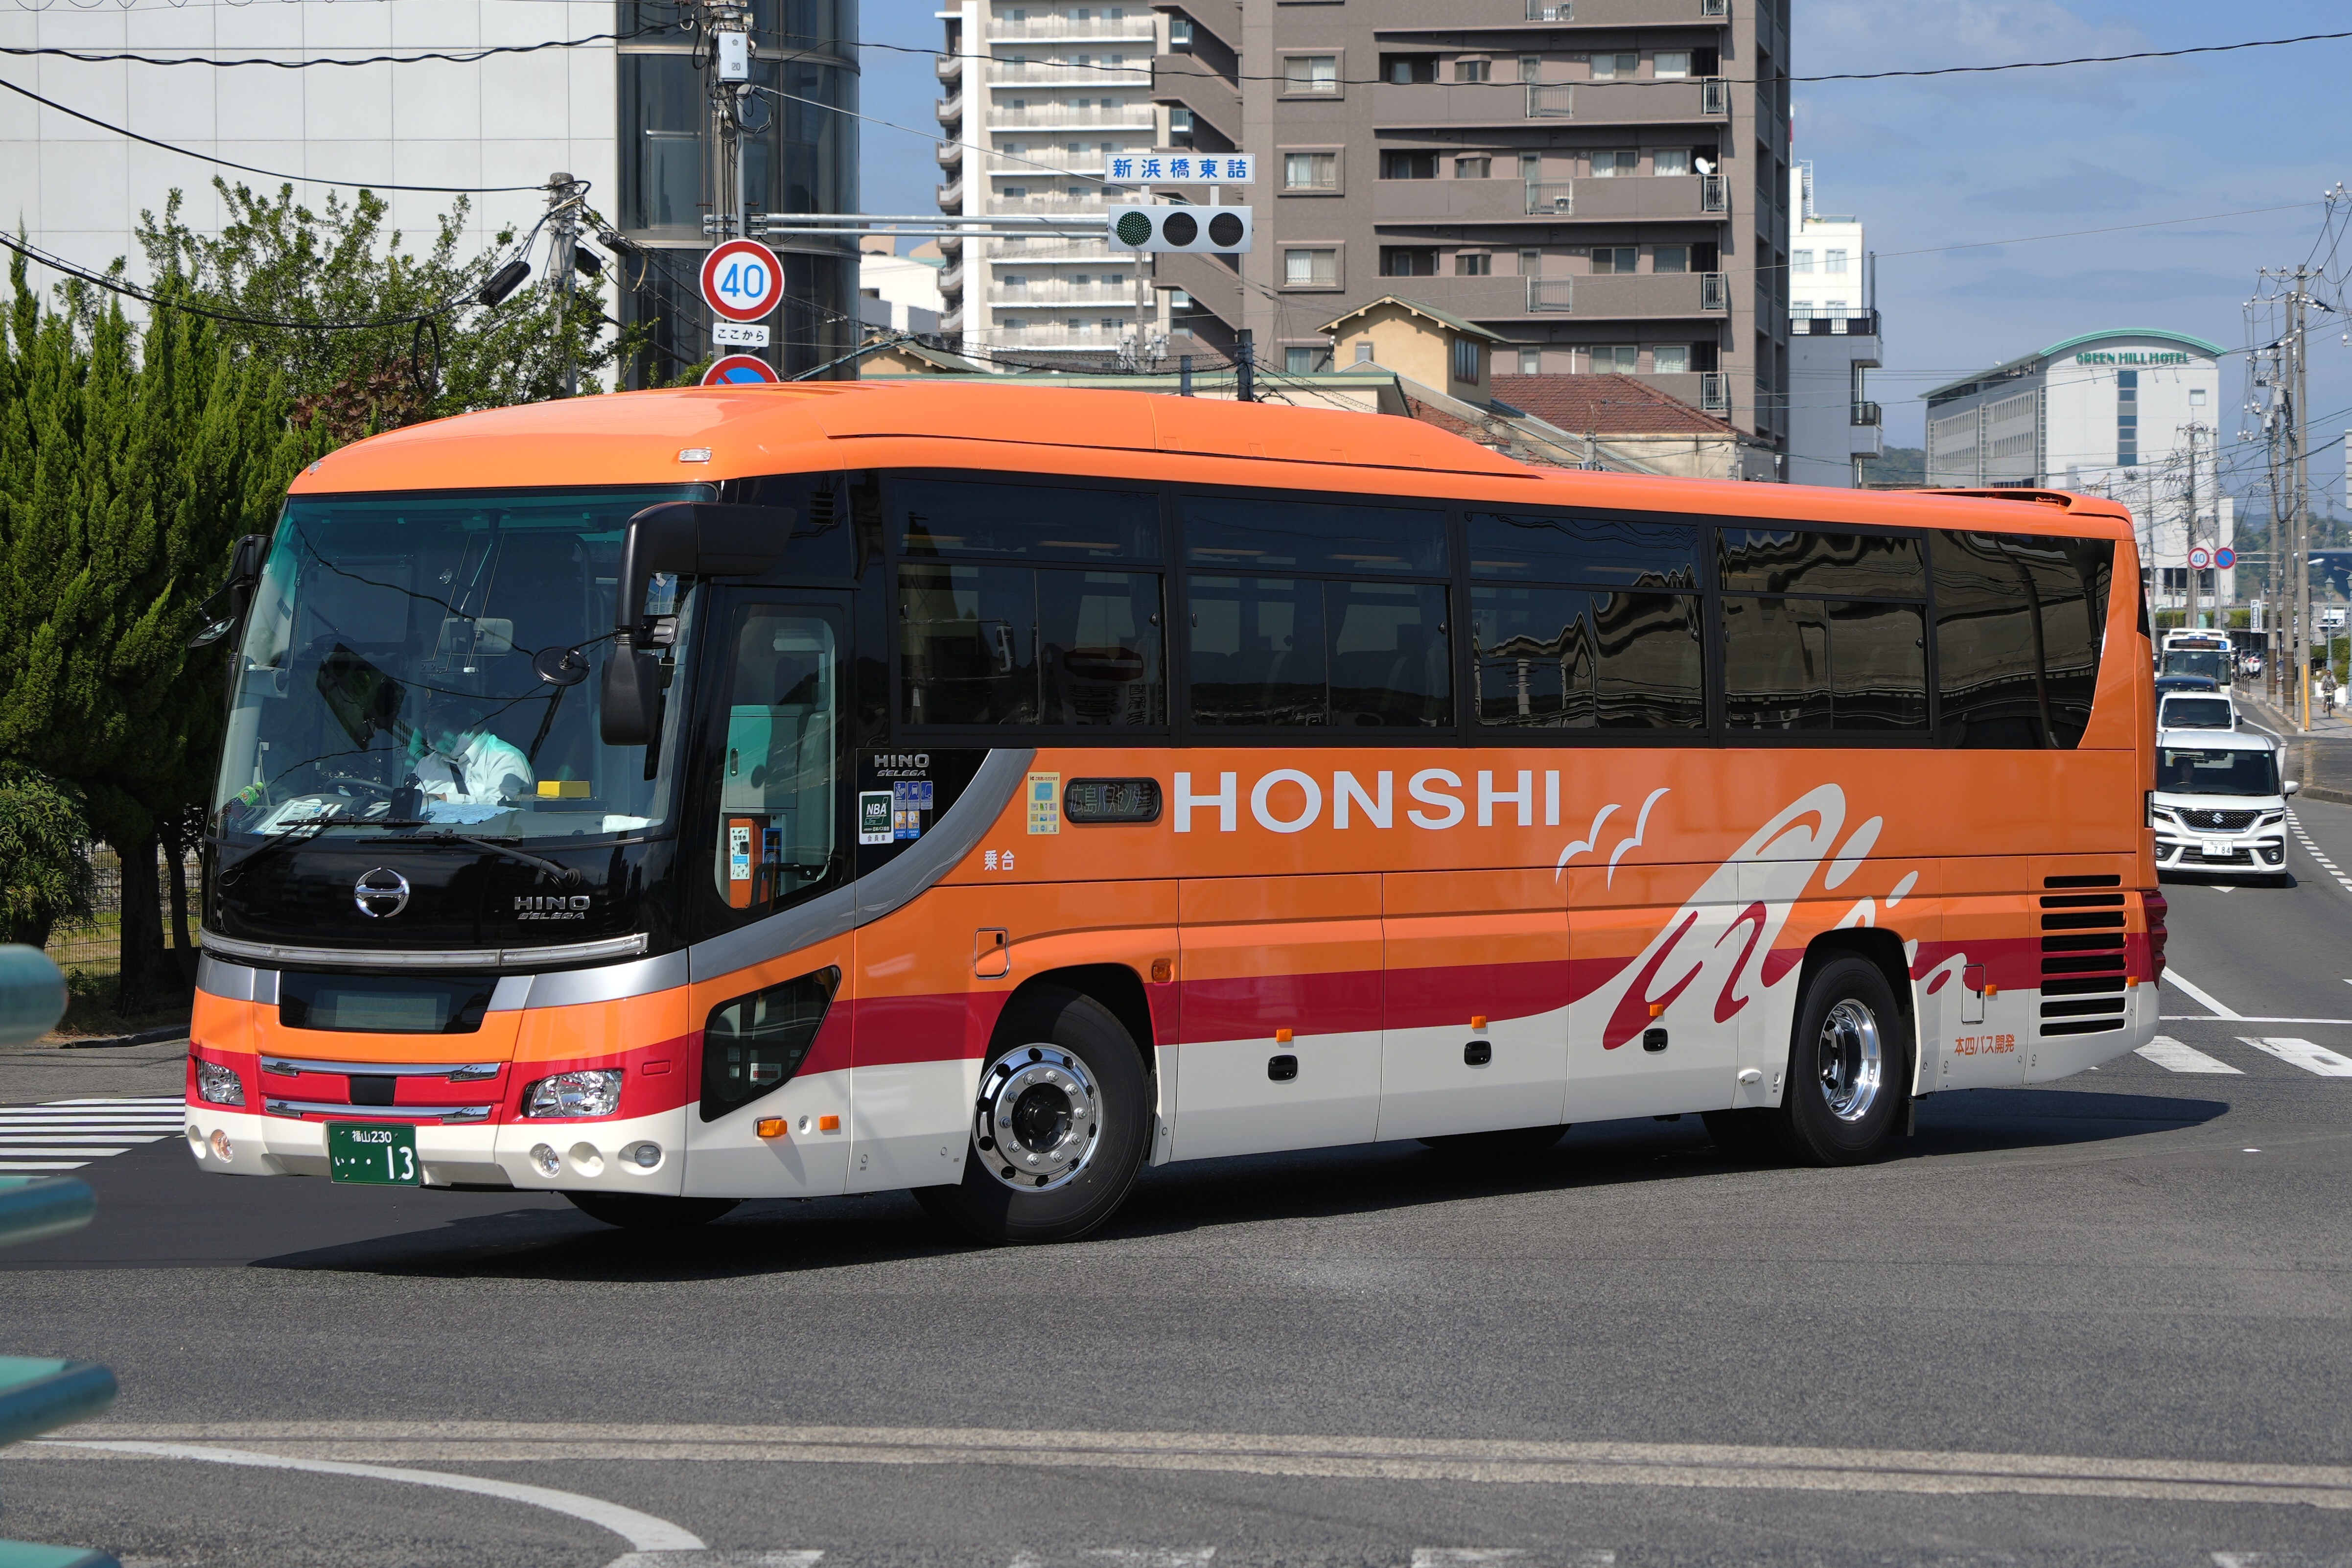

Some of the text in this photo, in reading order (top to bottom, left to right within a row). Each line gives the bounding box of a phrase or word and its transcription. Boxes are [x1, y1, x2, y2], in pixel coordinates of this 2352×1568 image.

[731, 62, 741, 71] 20
[1113, 158, 1247, 179] 新浜橋東詰
[721, 263, 764, 298] 40
[718, 328, 764, 341] ここから
[2076, 352, 2189, 365] GREEN HILL HOTEL
[2192, 554, 2205, 563] 40
[874, 753, 930, 768] HINO
[877, 769, 926, 777] SELEGA
[1173, 768, 1560, 833] HONSHI
[866, 803, 887, 815] NBA
[984, 849, 1015, 871] 乗合
[514, 895, 590, 911] HINO
[517, 911, 585, 920] SELEGA
[1954, 1033, 2015, 1056] 本四バス開発
[351, 1130, 392, 1144] 福山230
